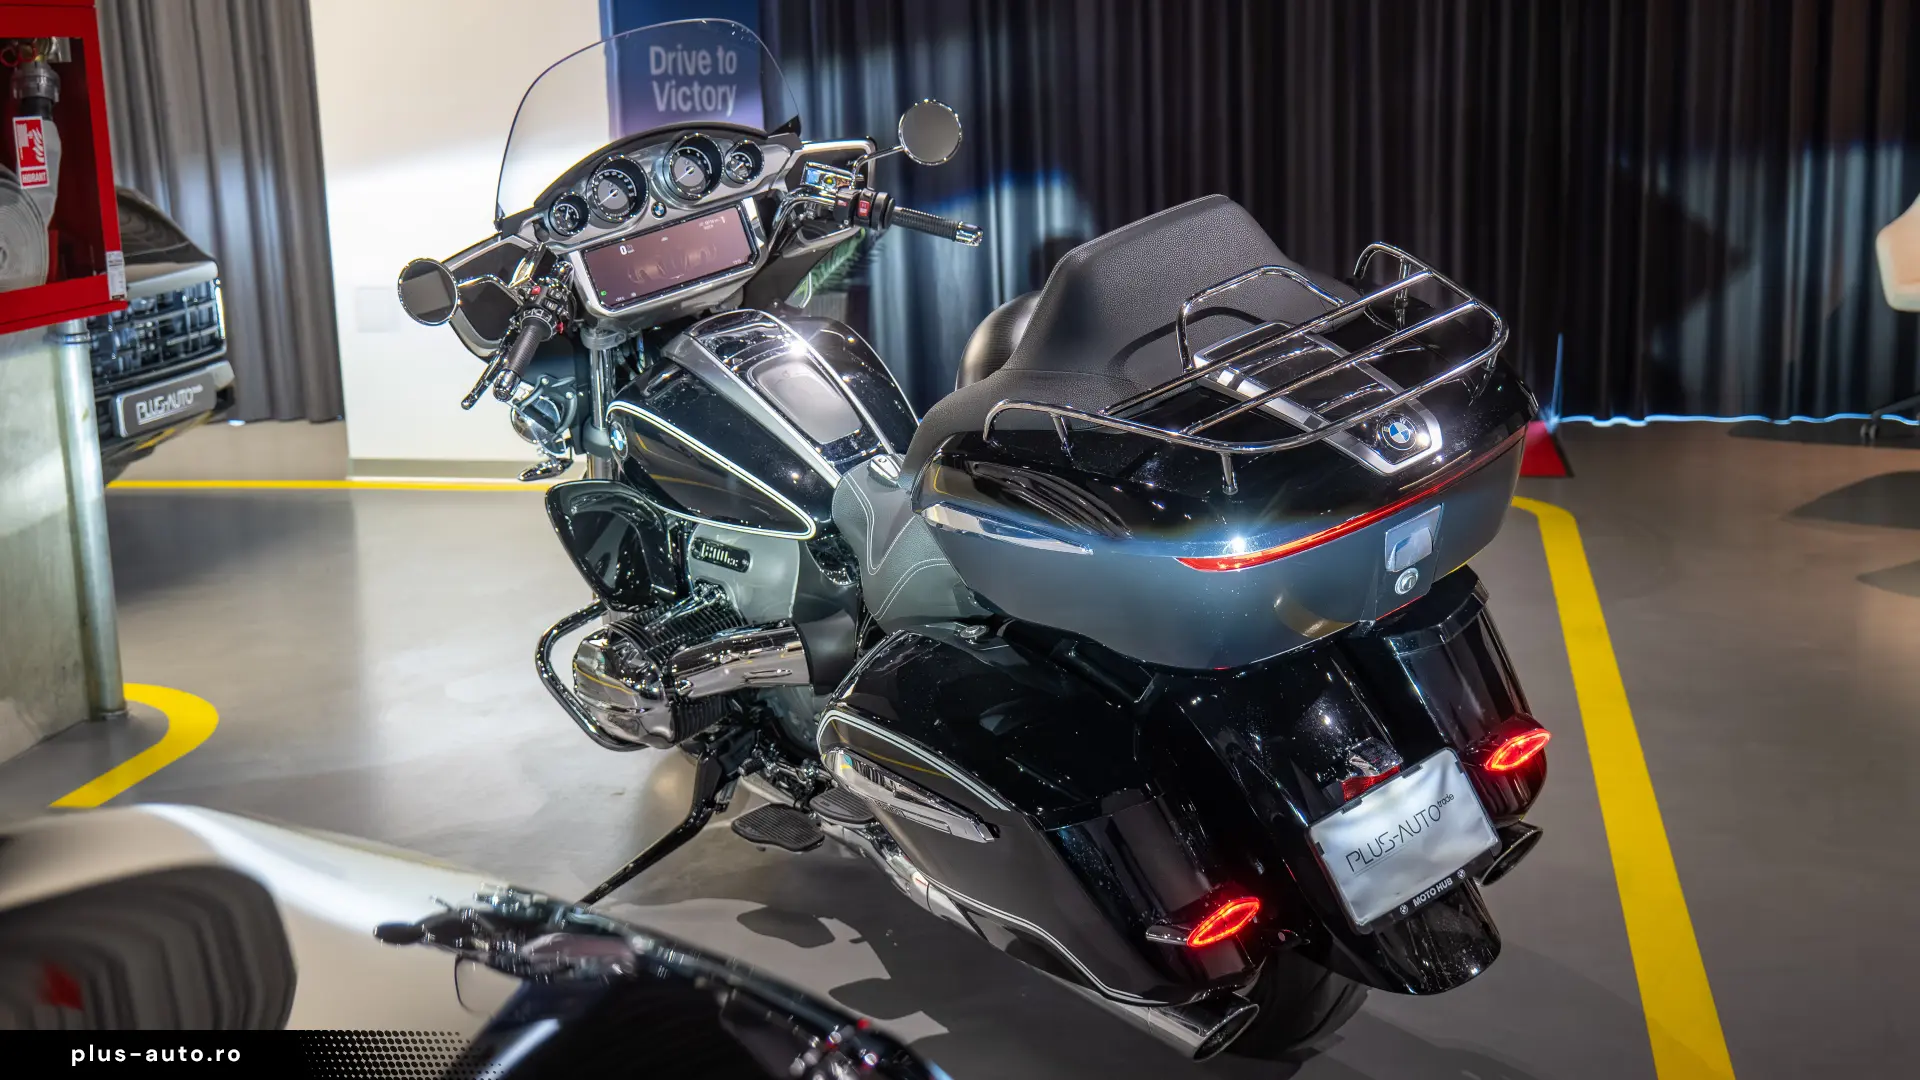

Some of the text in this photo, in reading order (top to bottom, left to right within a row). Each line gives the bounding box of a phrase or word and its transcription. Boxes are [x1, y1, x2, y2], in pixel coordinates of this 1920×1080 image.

[649, 43, 737, 76] Drive to
[652, 79, 737, 118] Victory
[1412, 877, 1453, 907] MOTO HUB
